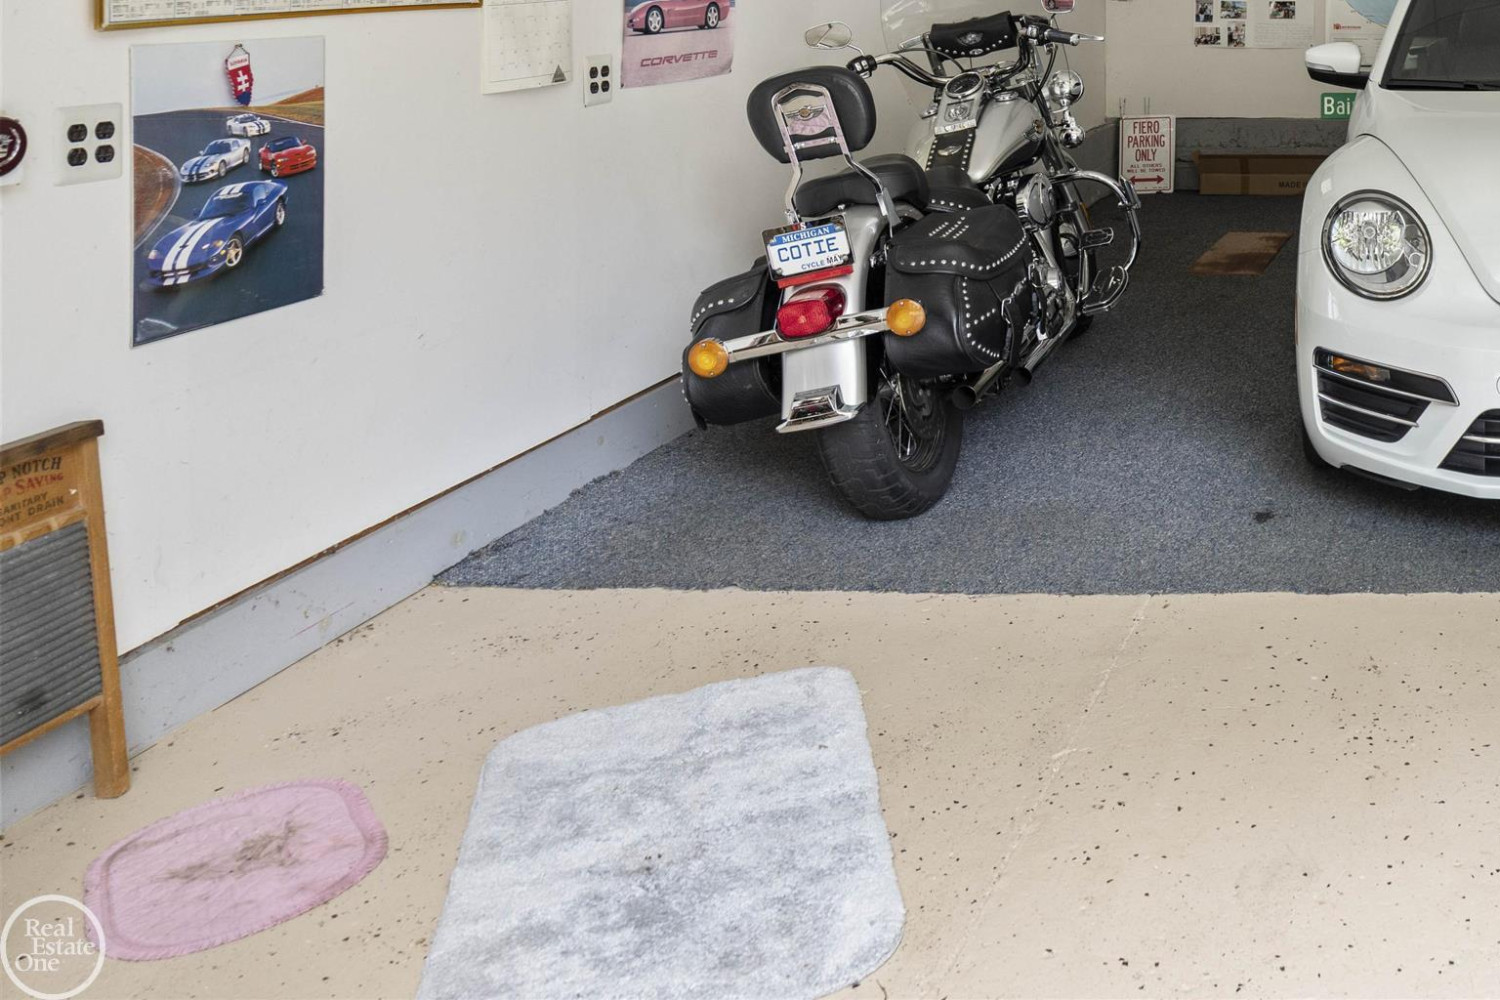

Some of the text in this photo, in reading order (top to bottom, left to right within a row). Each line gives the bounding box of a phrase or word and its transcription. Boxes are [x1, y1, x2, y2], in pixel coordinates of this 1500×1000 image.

[640, 50, 718, 68] CORVETTE
[1323, 97, 1354, 115] Bai
[1133, 121, 1160, 134] FIERO
[1128, 135, 1165, 148] PARKING
[1136, 149, 1157, 161] ONLY
[1279, 181, 1301, 189] MADE
[782, 226, 830, 243] MICHIGAN
[777, 236, 839, 262] COTIE
[801, 254, 843, 270] CYCLE MAY
[12, 456, 62, 478] NOTCH
[15, 472, 64, 495] SAVING
[28, 496, 64, 516] DRAIN
